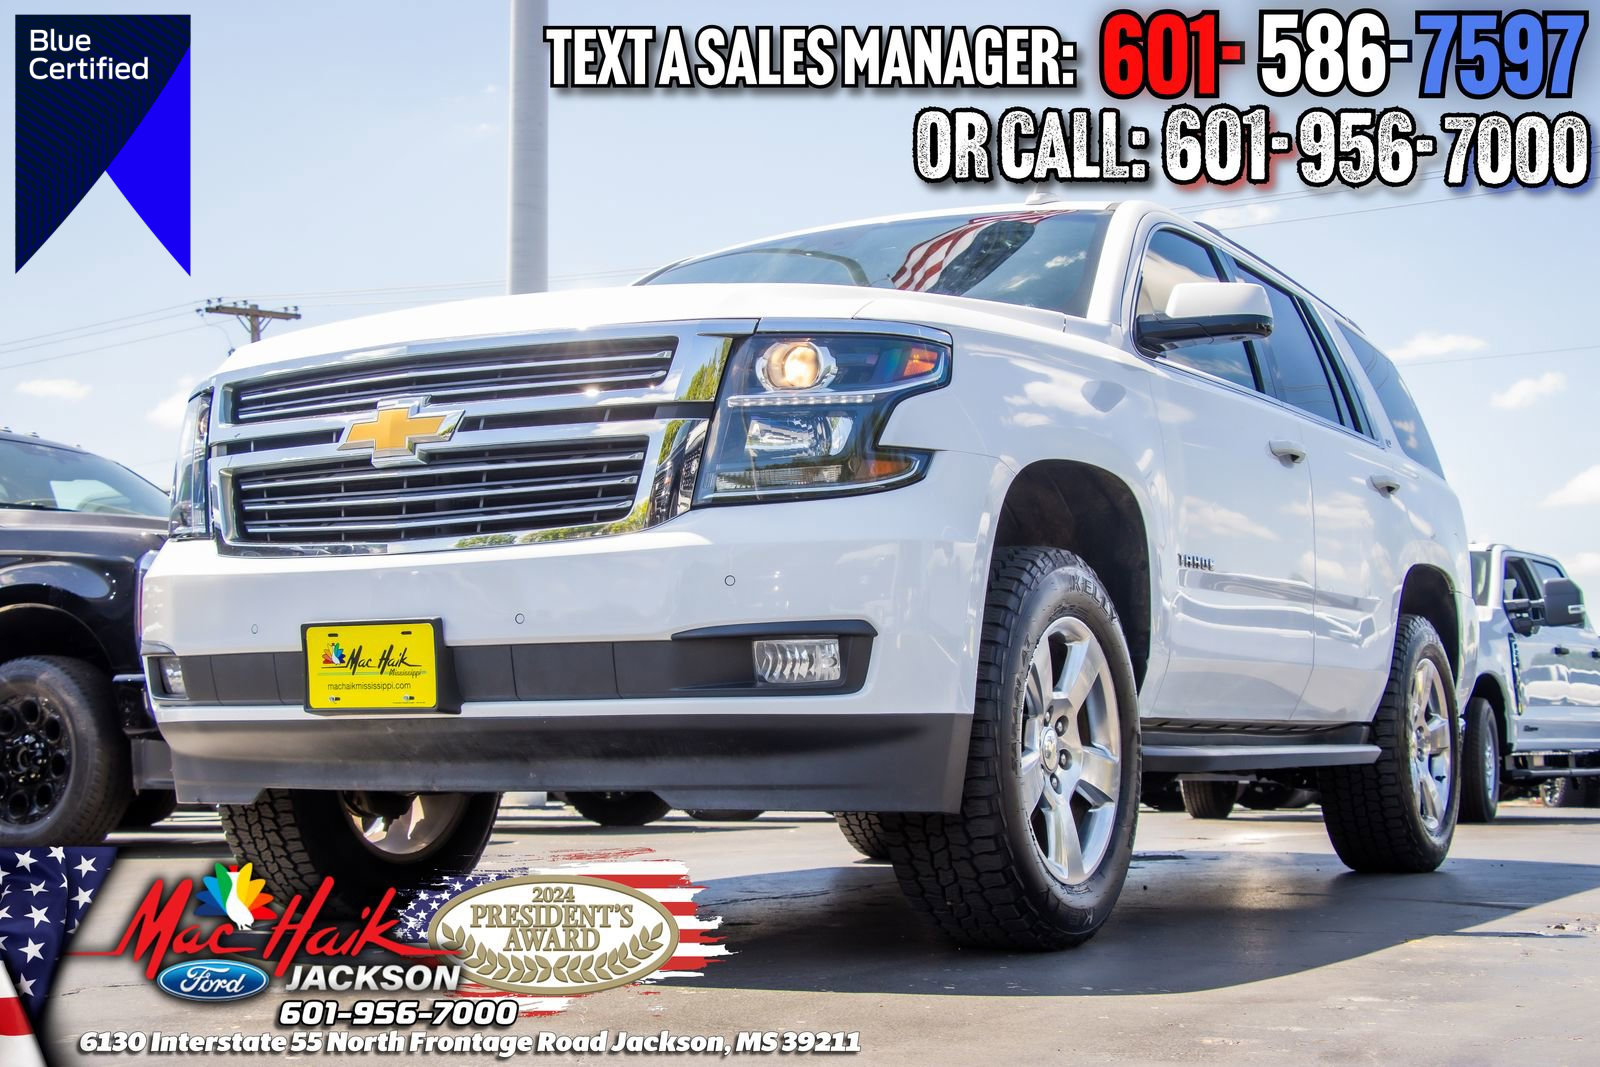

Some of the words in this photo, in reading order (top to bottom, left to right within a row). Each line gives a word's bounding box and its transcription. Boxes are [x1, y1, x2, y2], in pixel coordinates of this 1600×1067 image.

[346, 645, 374, 675] Mac
[378, 644, 421, 675] Haik
[389, 668, 422, 678] Mississippi
[327, 682, 412, 692] machaikmississippi.com
